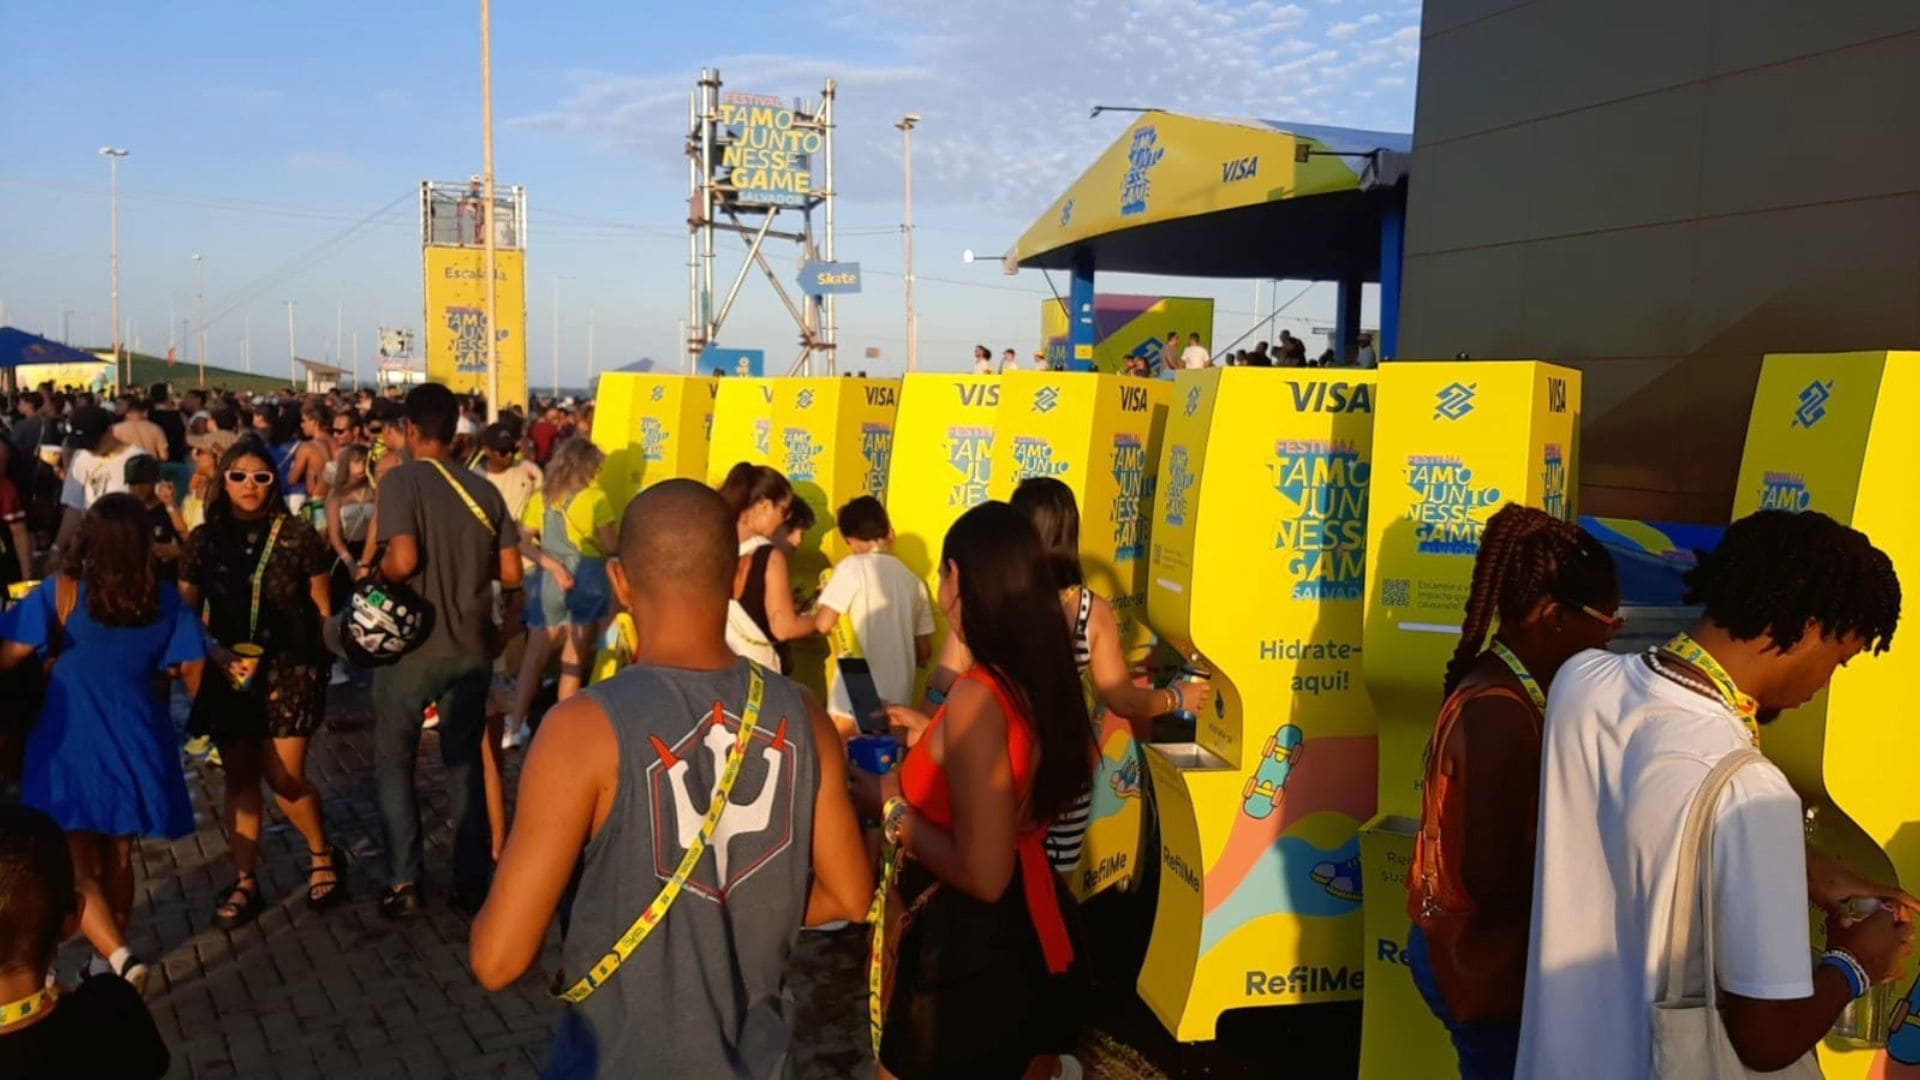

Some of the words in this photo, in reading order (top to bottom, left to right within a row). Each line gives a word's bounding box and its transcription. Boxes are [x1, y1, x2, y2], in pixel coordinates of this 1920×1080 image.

[719, 104, 794, 129] TAMO
[735, 126, 822, 153] JUNTO
[722, 147, 799, 171] NESSE
[1222, 156, 1258, 183] VISA
[731, 167, 811, 193] GAME
[818, 272, 857, 285] Skate
[864, 386, 895, 407] VISA
[953, 383, 1000, 406] VIS
[1119, 385, 1148, 411] VISA
[1284, 381, 1372, 413] VISA
[1548, 377, 1566, 413] VISA
[943, 438, 994, 461] TAM
[1266, 456, 1370, 488] TAMO
[1402, 465, 1473, 486] TAMO
[1293, 488, 1362, 519] JUN
[1420, 484, 1502, 506] JUNTO
[1270, 519, 1366, 551] NESS
[1287, 551, 1365, 583] GAM
[1292, 586, 1362, 601] SALVAD
[1260, 639, 1363, 660] Hidrate-
[1291, 671, 1350, 694] aqui!
[1163, 845, 1200, 893] RefilMe
[1246, 967, 1365, 996] RefilMe
